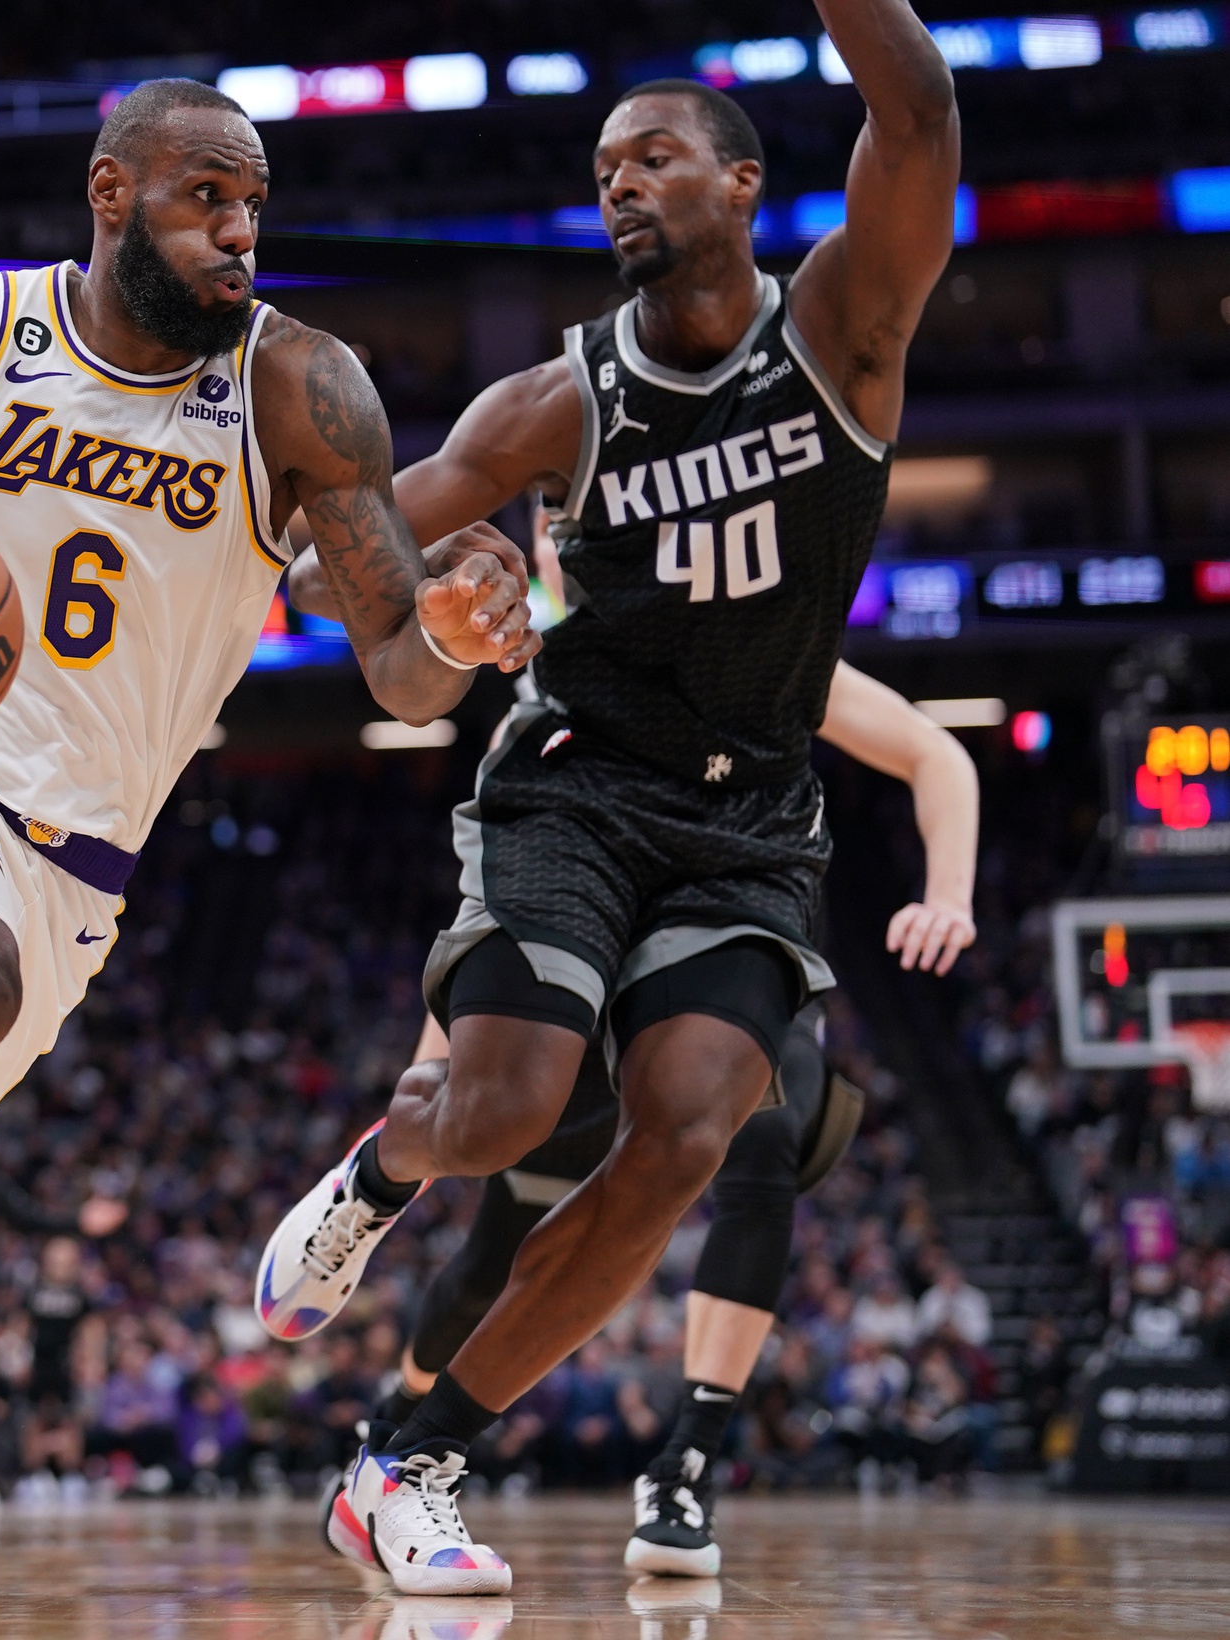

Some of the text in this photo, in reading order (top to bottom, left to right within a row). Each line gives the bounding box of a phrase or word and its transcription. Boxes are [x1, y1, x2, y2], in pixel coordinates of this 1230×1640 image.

[20, 322, 43, 352] 6
[598, 360, 617, 390] 6
[183, 402, 241, 428] bibigo
[599, 411, 824, 527] KINGS
[656, 499, 782, 603] 40
[39, 527, 128, 672] 6
